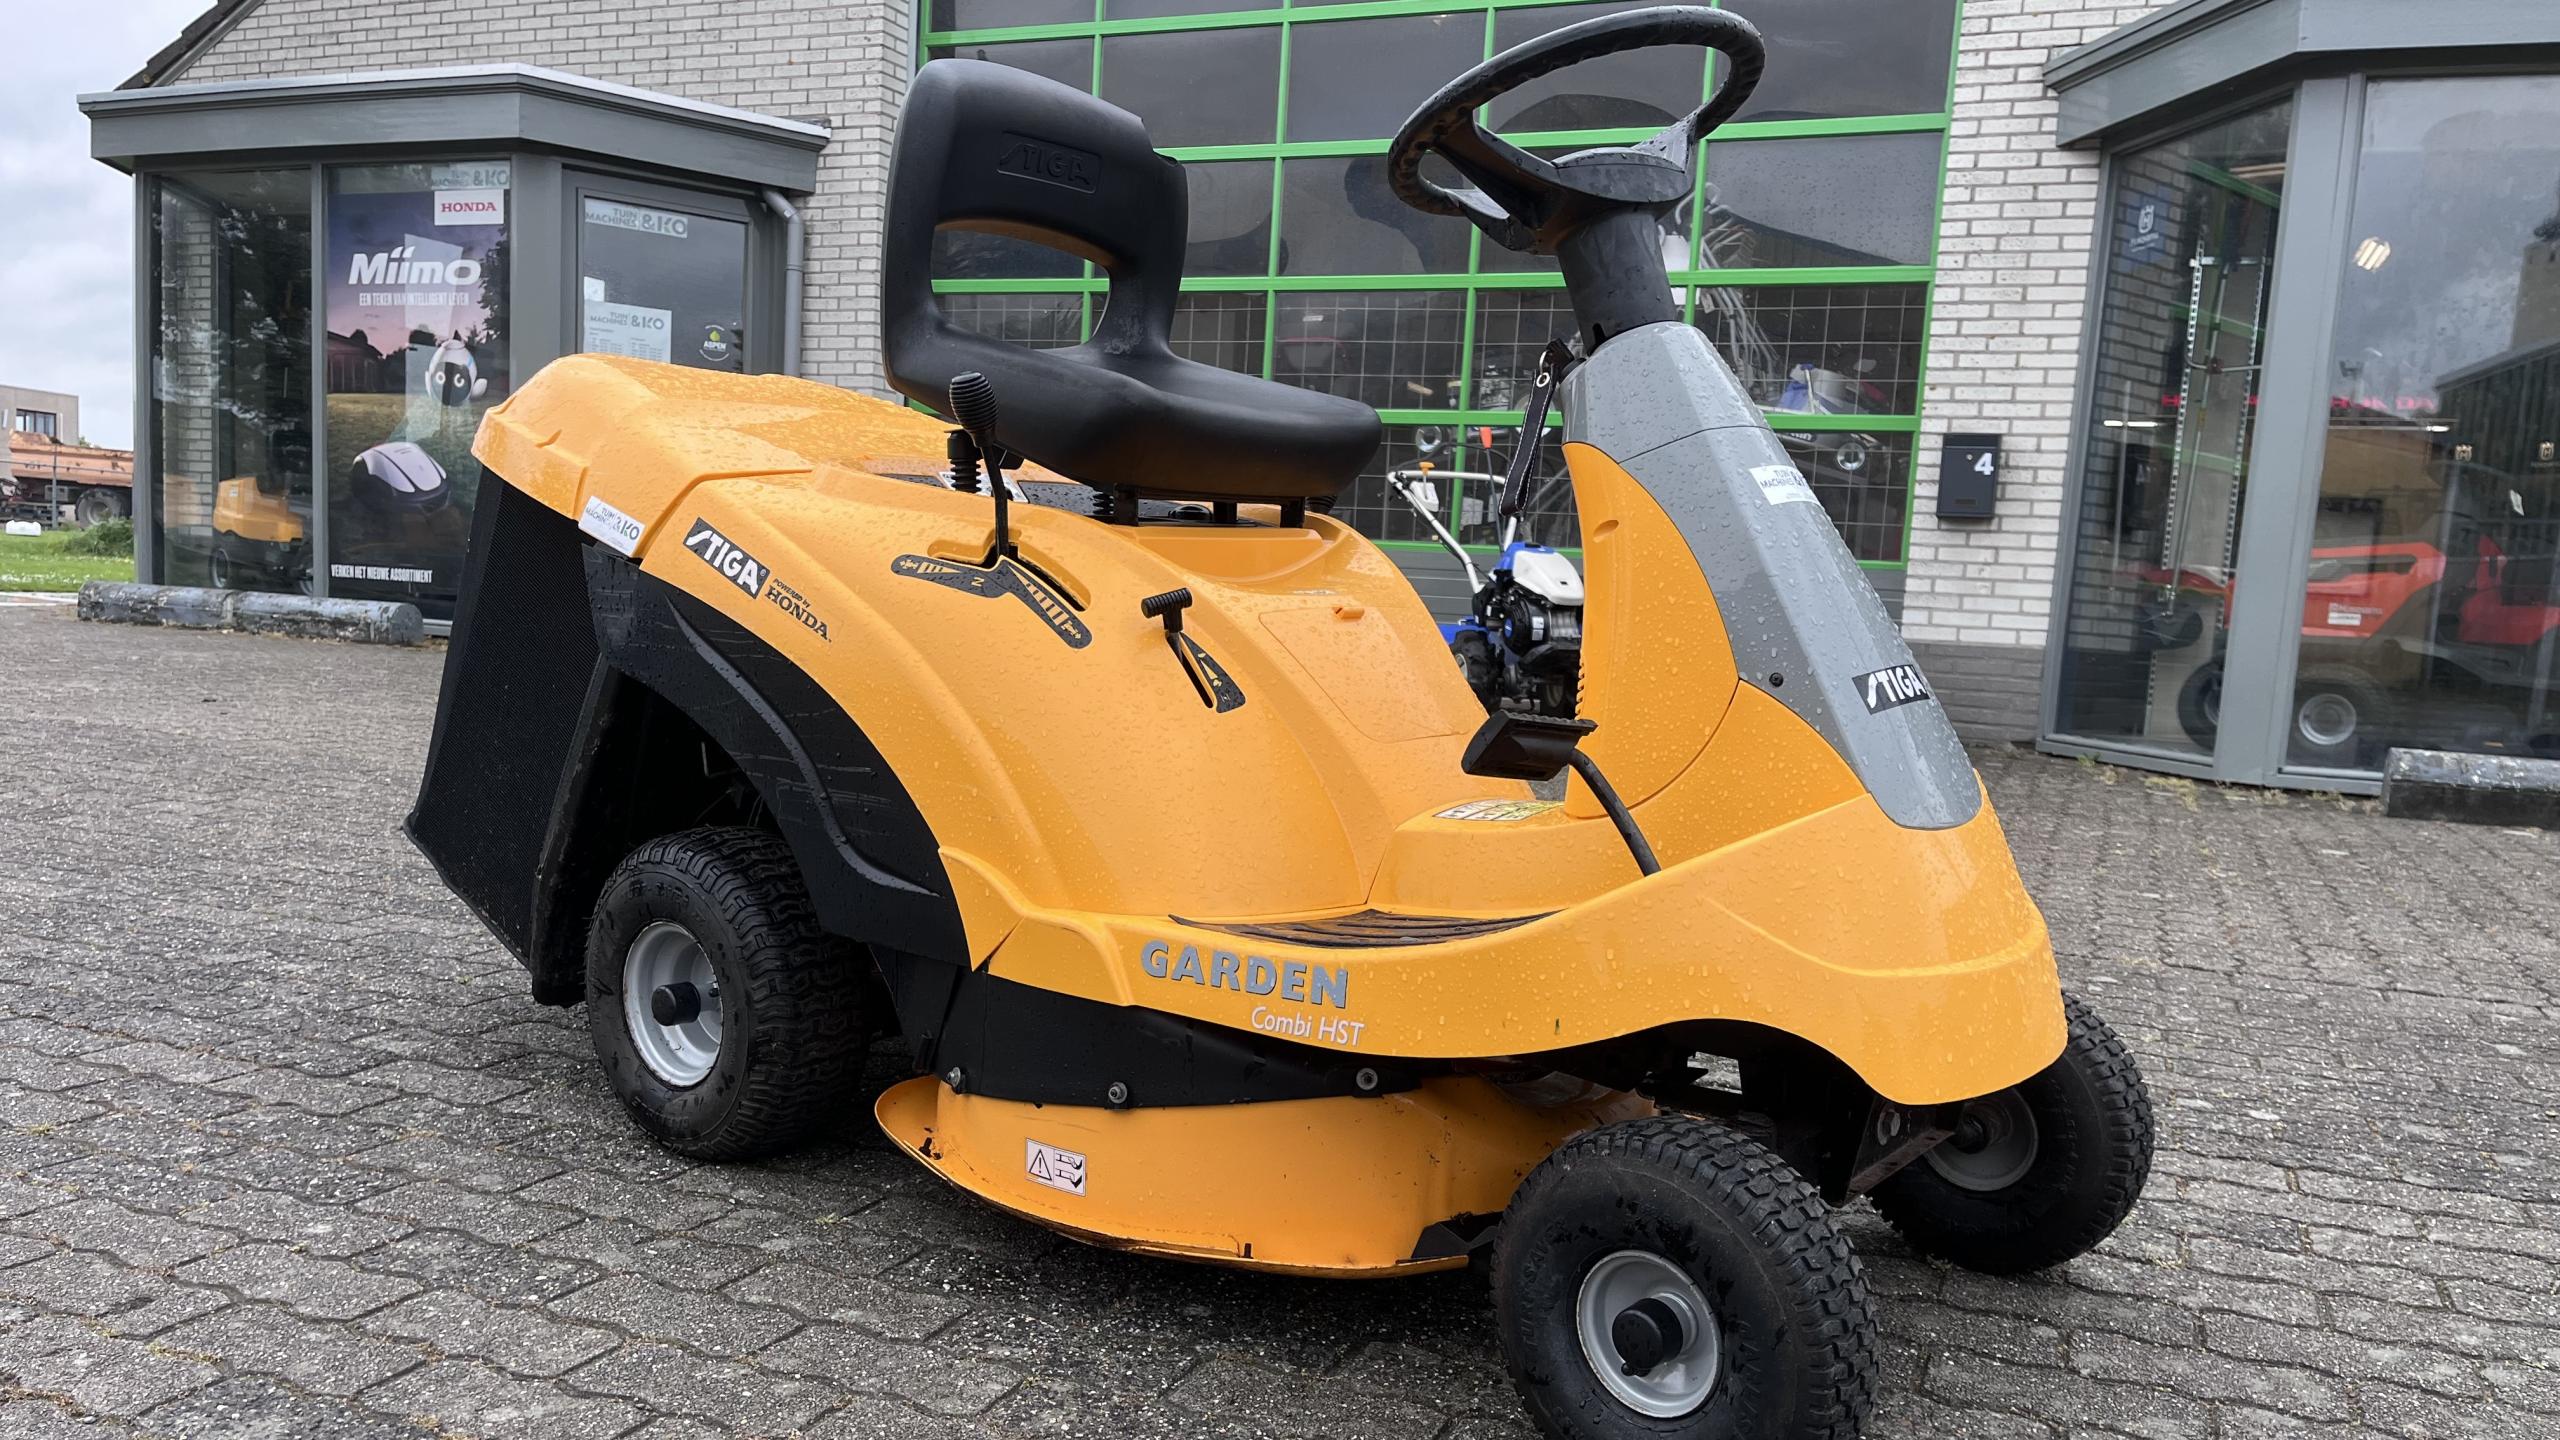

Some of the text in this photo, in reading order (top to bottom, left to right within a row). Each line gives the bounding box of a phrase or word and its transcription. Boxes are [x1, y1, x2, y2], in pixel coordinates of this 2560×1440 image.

[999, 142, 1091, 186] STIGA
[441, 202, 496, 213] HONDA
[612, 207, 638, 219] TUIN
[585, 212, 638, 228] MACHINES
[642, 213, 687, 236] &KO
[347, 246, 481, 285] Miimo
[632, 315, 664, 330] &KO
[1974, 453, 1994, 476] 4
[331, 564, 433, 583] VERKEN HET NIEUWE ASSORTIMENT
[686, 530, 759, 595] STIGA
[802, 599, 812, 608] by
[1867, 666, 1927, 709] STIGA
[1141, 939, 1349, 1009] GARDEN
[1251, 1006, 1364, 1046] Combi HST
